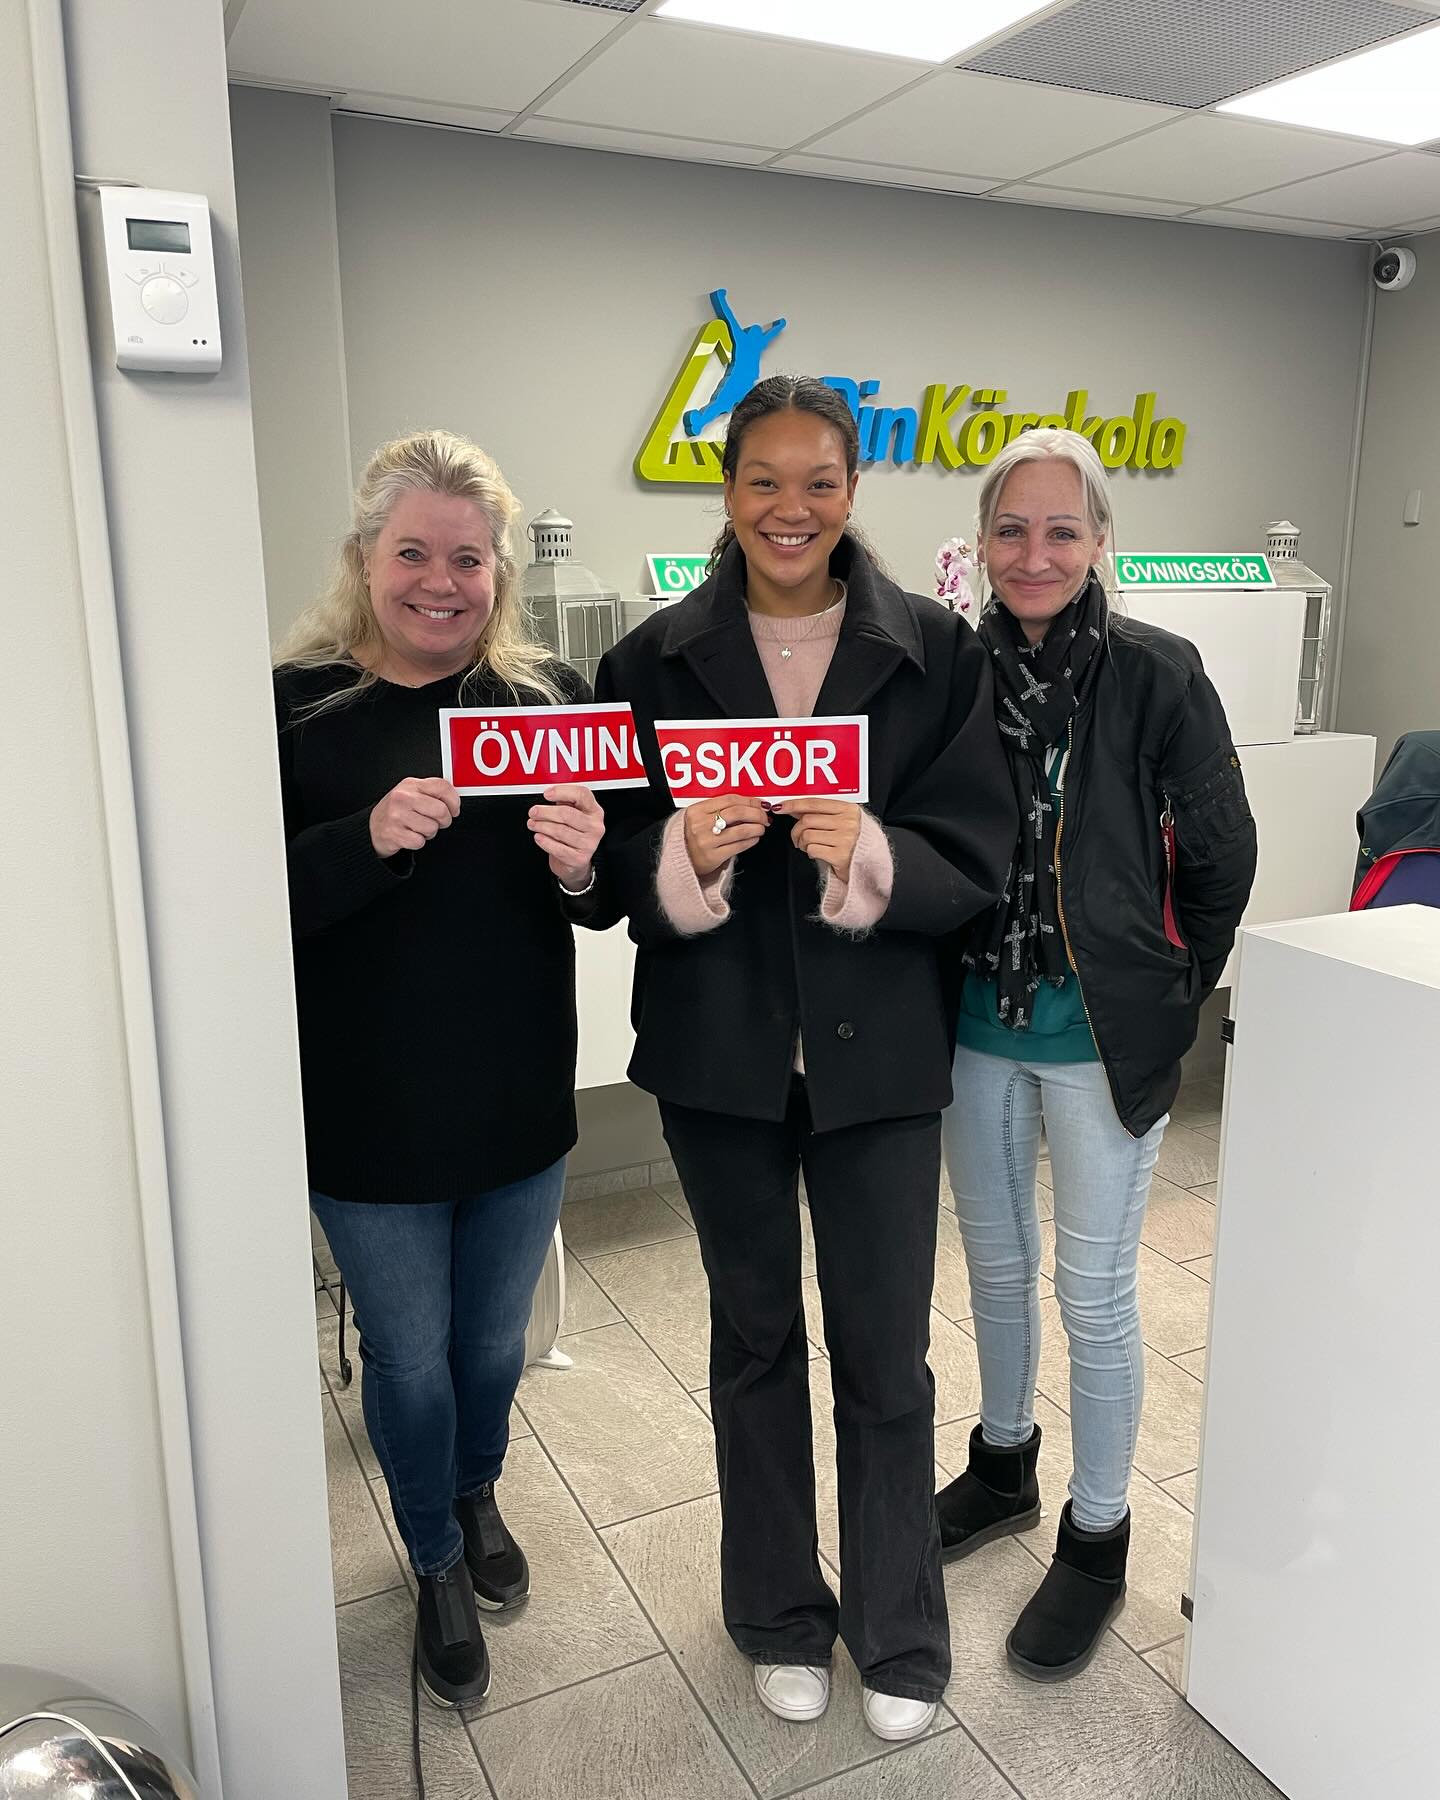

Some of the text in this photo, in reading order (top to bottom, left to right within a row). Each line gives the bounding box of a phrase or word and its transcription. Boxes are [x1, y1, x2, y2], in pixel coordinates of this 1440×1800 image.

[1122, 558, 1264, 581] ÖVNINGSKÖR
[473, 720, 643, 776] ÖVNIN
[661, 731, 838, 788] GSKÖR
